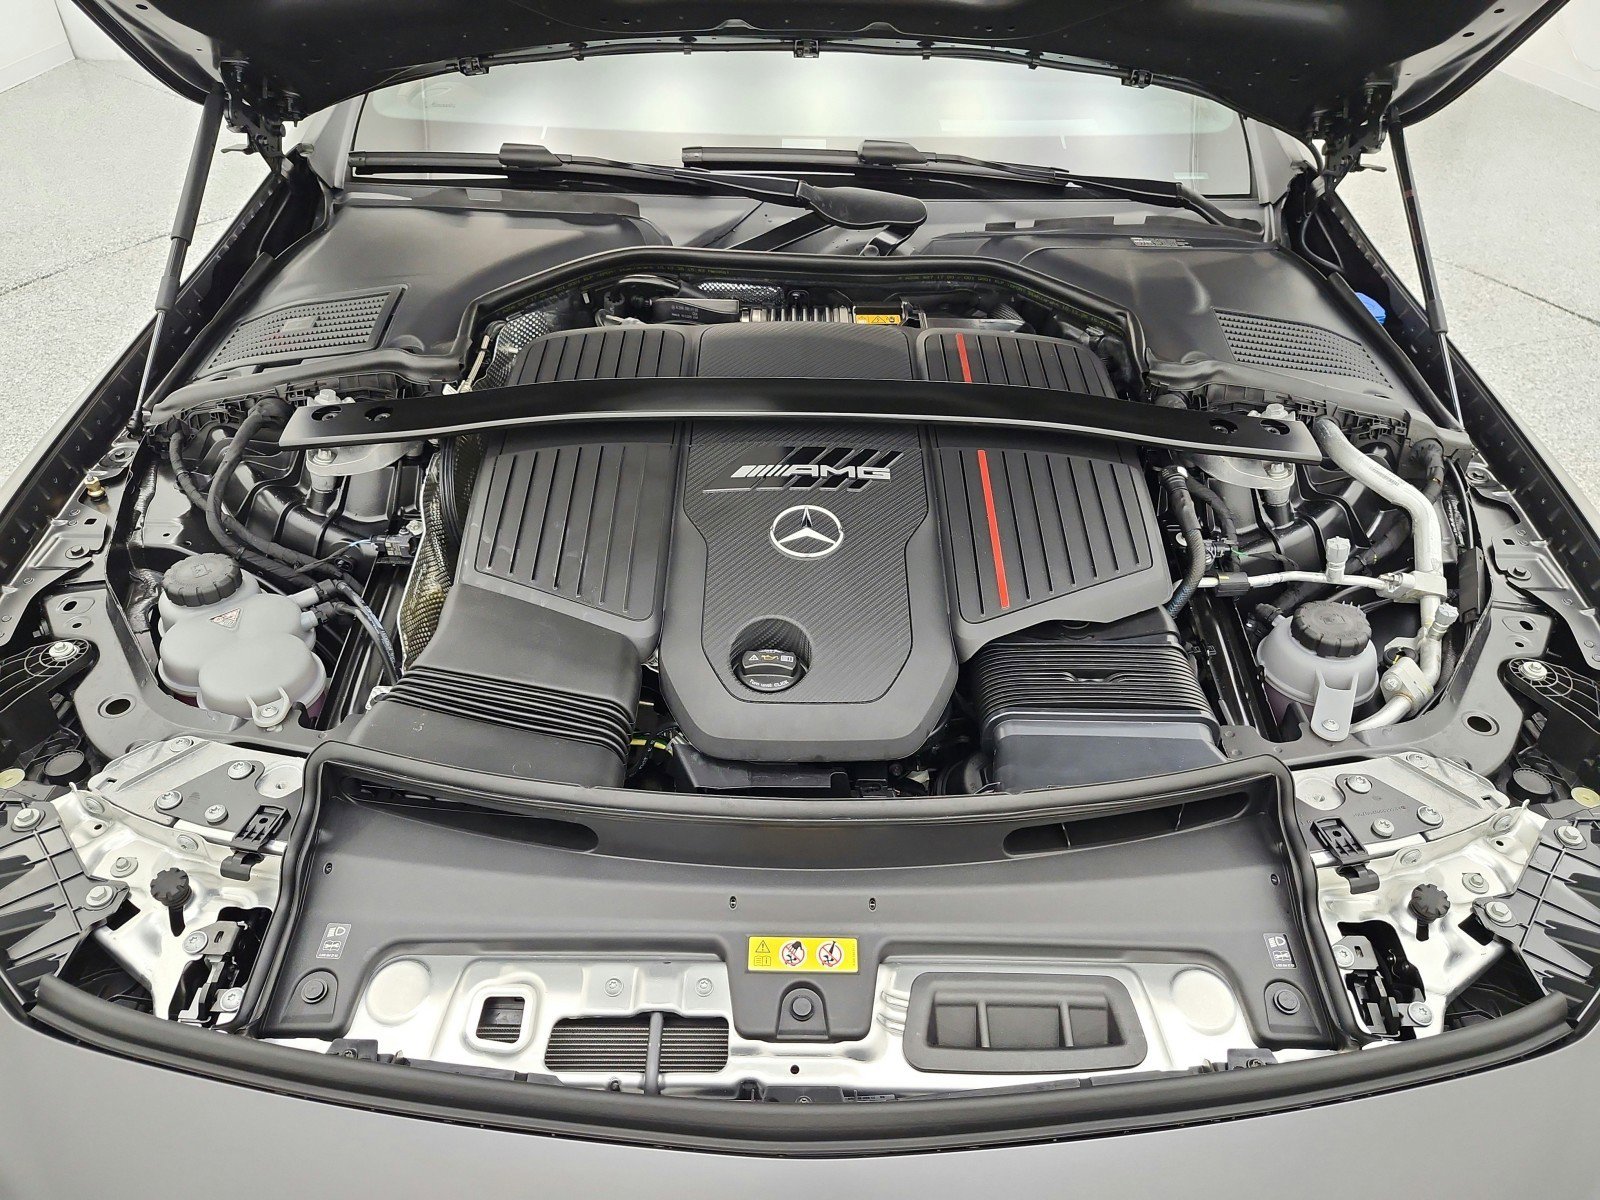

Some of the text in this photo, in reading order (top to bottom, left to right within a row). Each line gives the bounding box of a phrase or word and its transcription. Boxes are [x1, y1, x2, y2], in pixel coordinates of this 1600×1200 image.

[781, 464, 891, 480] AMG
[749, 678, 760, 686] Turn
[773, 679, 789, 688] CLICK
